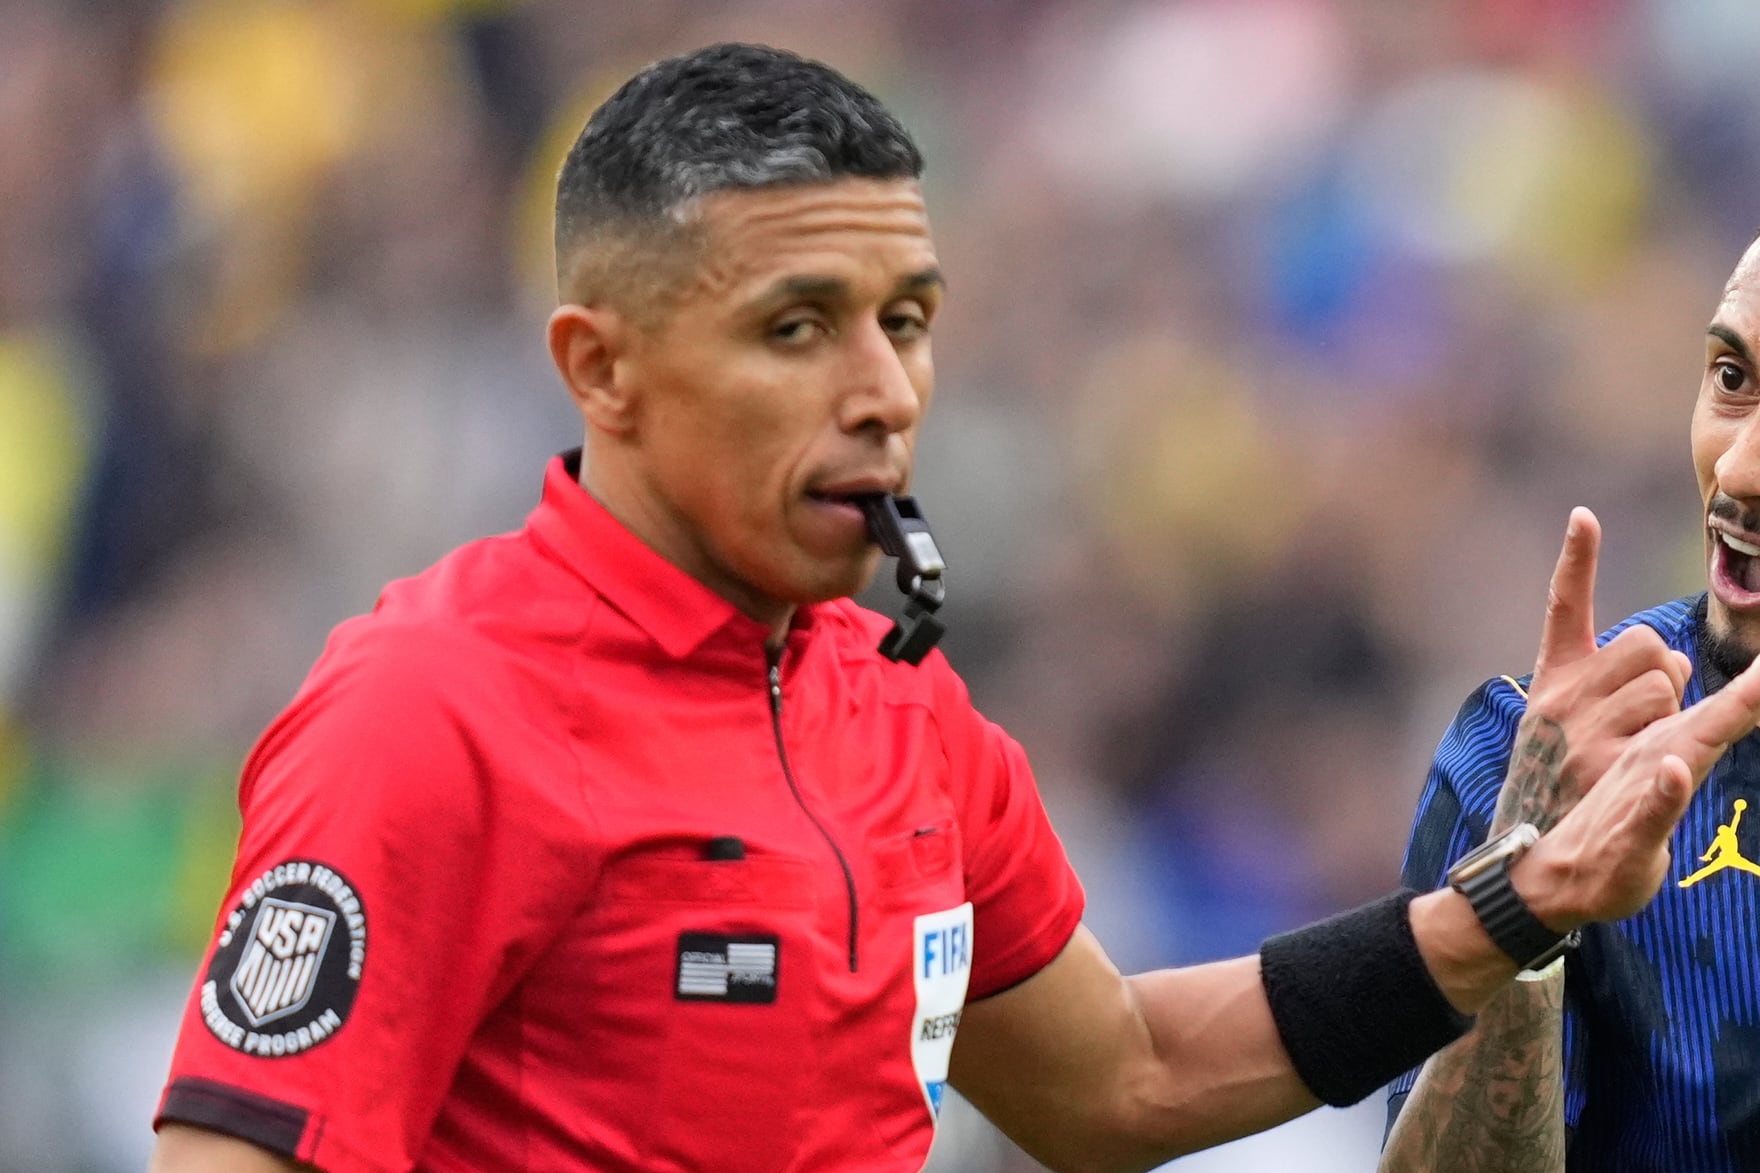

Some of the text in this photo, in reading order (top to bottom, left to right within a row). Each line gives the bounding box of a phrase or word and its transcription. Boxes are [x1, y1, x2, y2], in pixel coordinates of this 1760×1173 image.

[258, 905, 328, 960] USA
[924, 923, 967, 978] FIFA
[243, 1008, 342, 1057] PROGRAM
